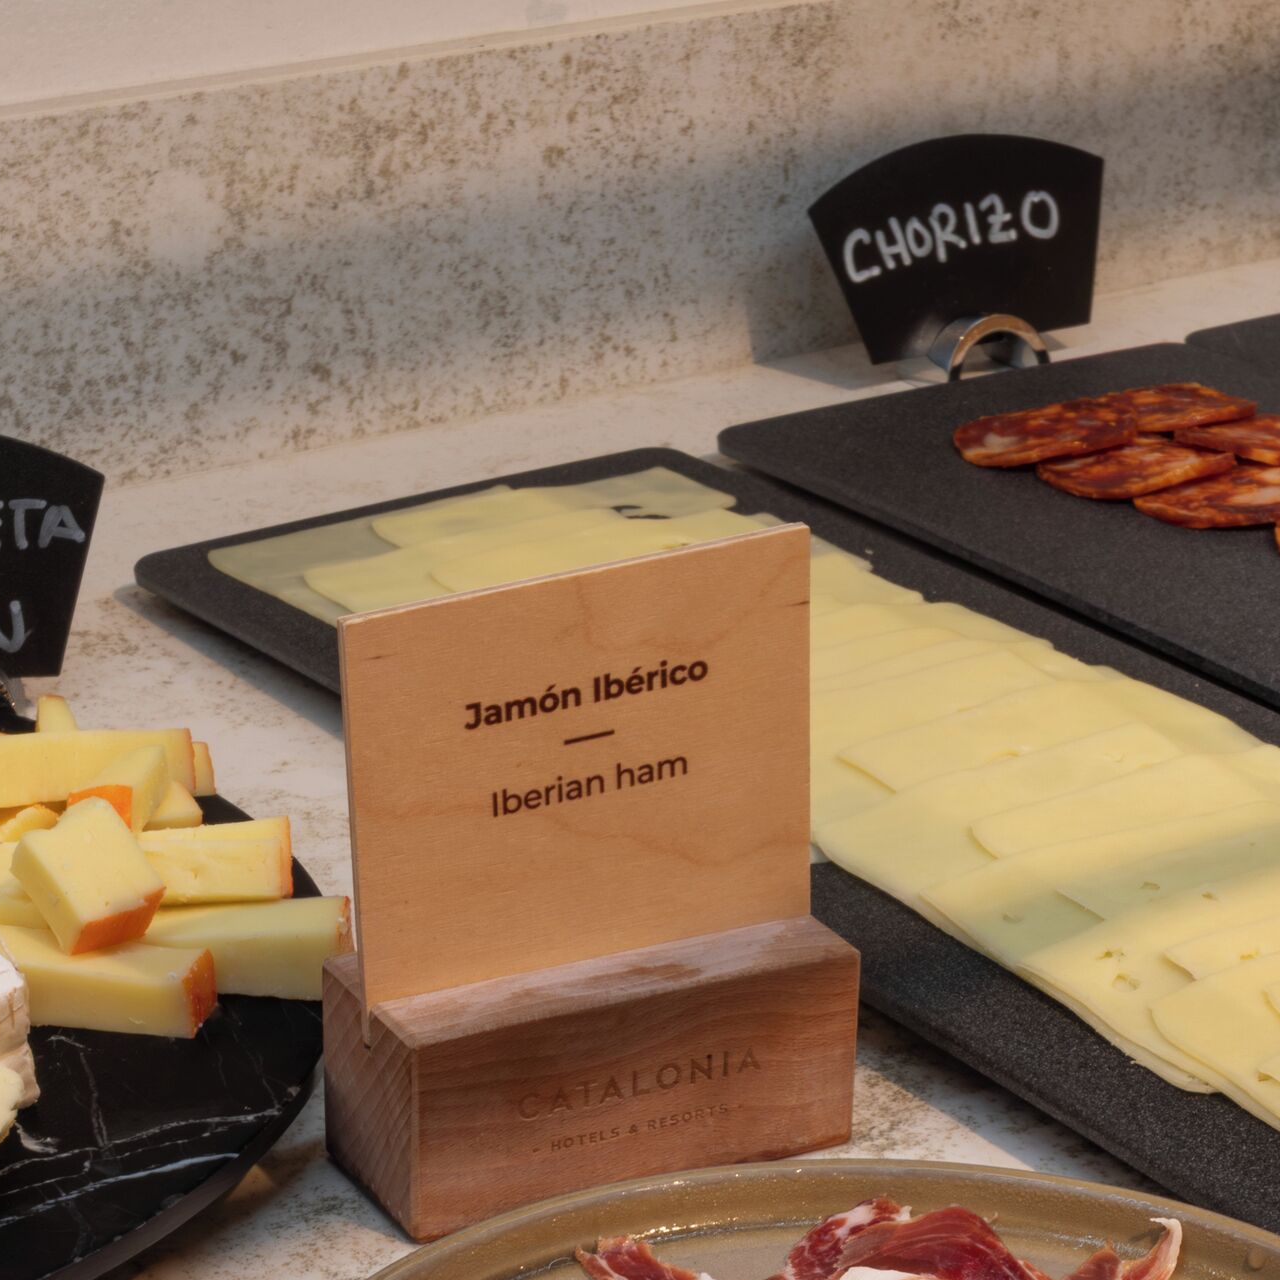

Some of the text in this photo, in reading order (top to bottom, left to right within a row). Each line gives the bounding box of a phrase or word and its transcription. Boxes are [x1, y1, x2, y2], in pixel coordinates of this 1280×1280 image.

[842, 190, 1060, 283] CHORIZO
[463, 657, 709, 731] Jamón Ibérico
[491, 754, 689, 818] Iberian ham
[517, 1047, 762, 1121] CATALONIA
[550, 1126, 620, 1152] HOTELS
[646, 1102, 729, 1131] RESORTS
